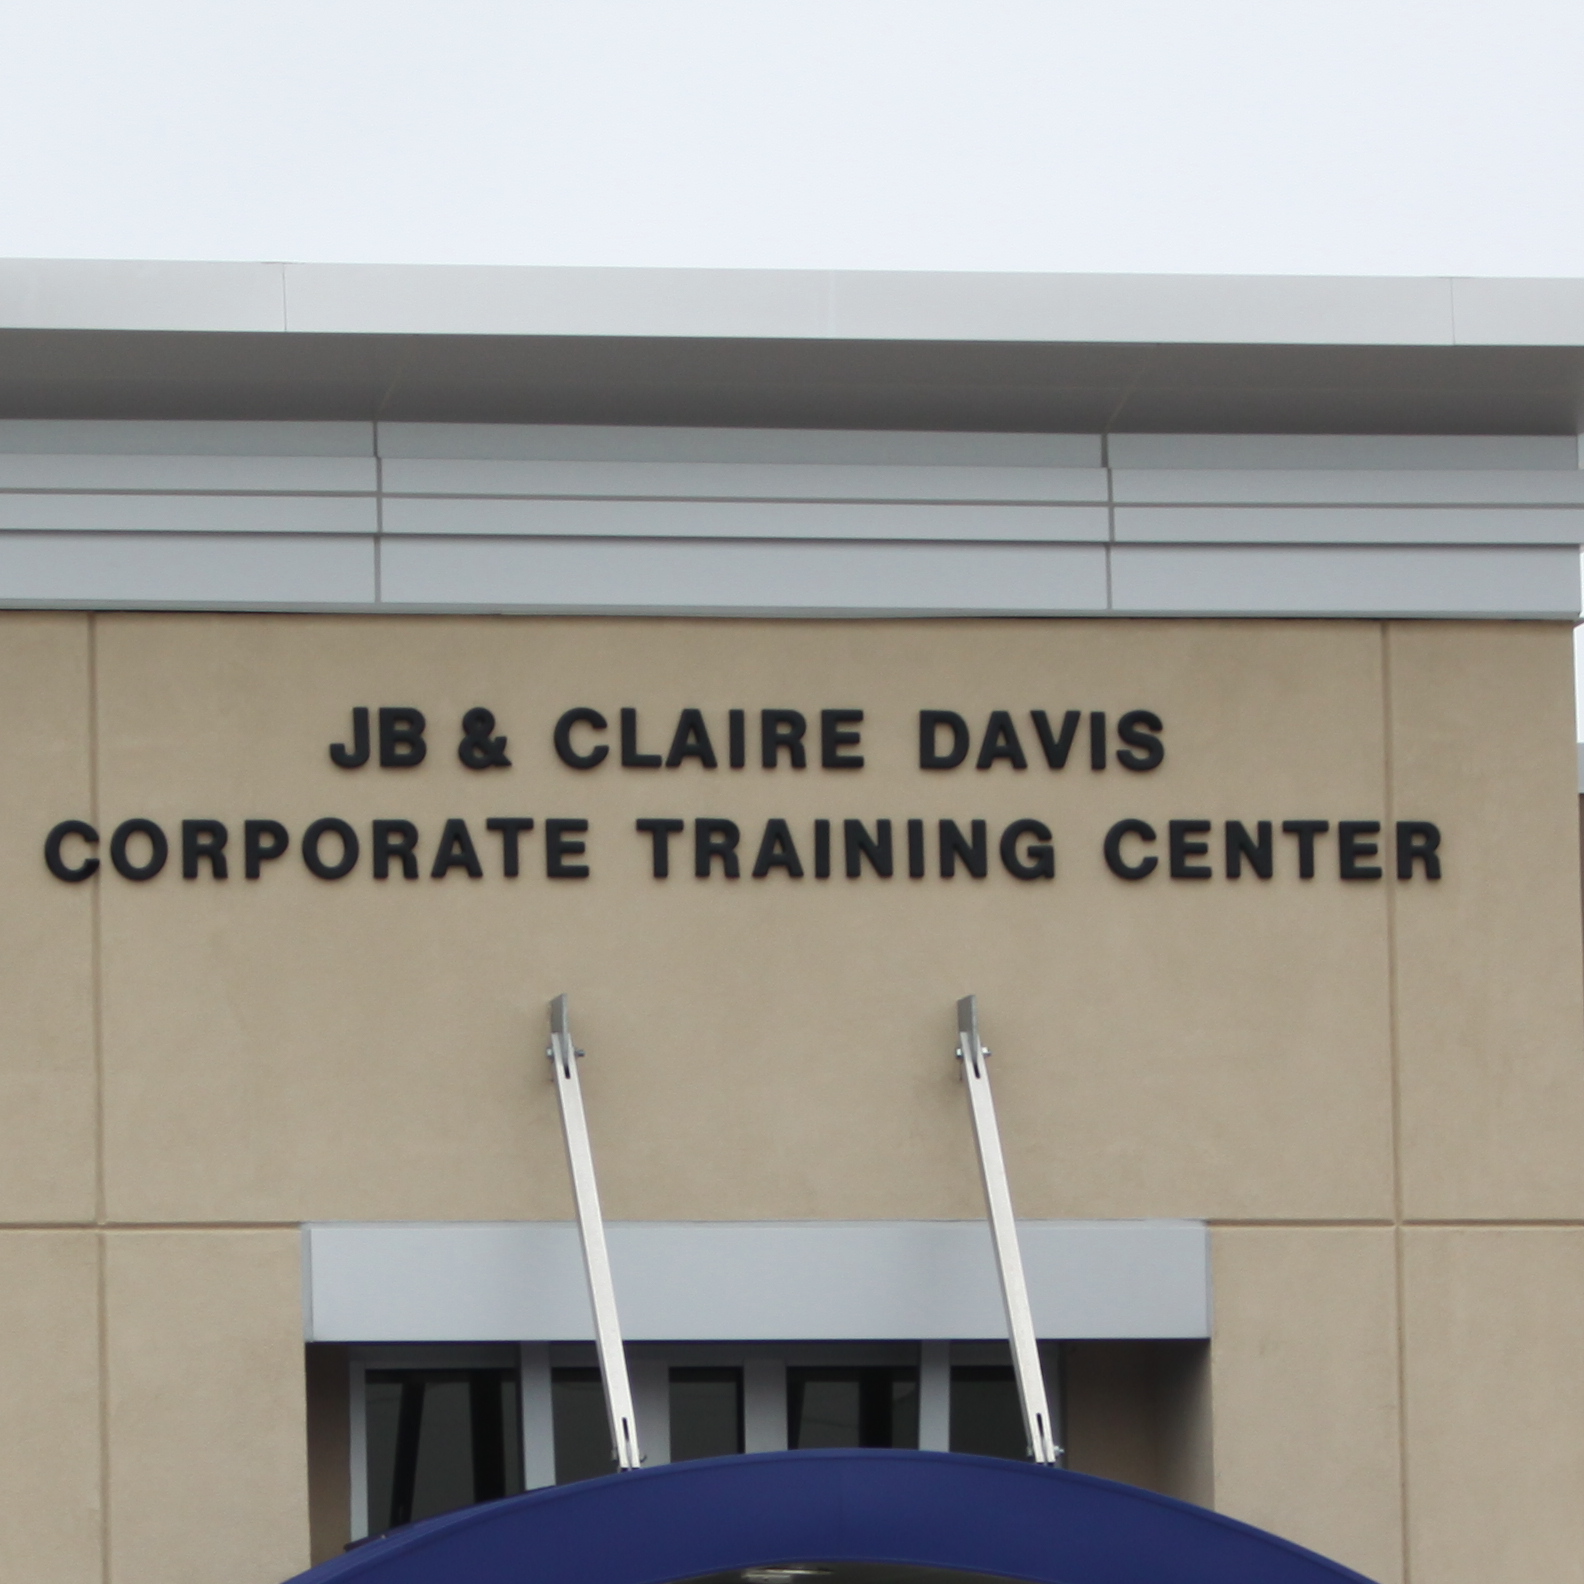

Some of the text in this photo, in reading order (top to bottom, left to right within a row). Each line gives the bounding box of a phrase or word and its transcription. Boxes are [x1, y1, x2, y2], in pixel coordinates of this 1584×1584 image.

[329, 706, 1165, 775] JB & CLAIRE DAVIS
[43, 817, 1442, 885] CORPORATE TRAINING CENTER
